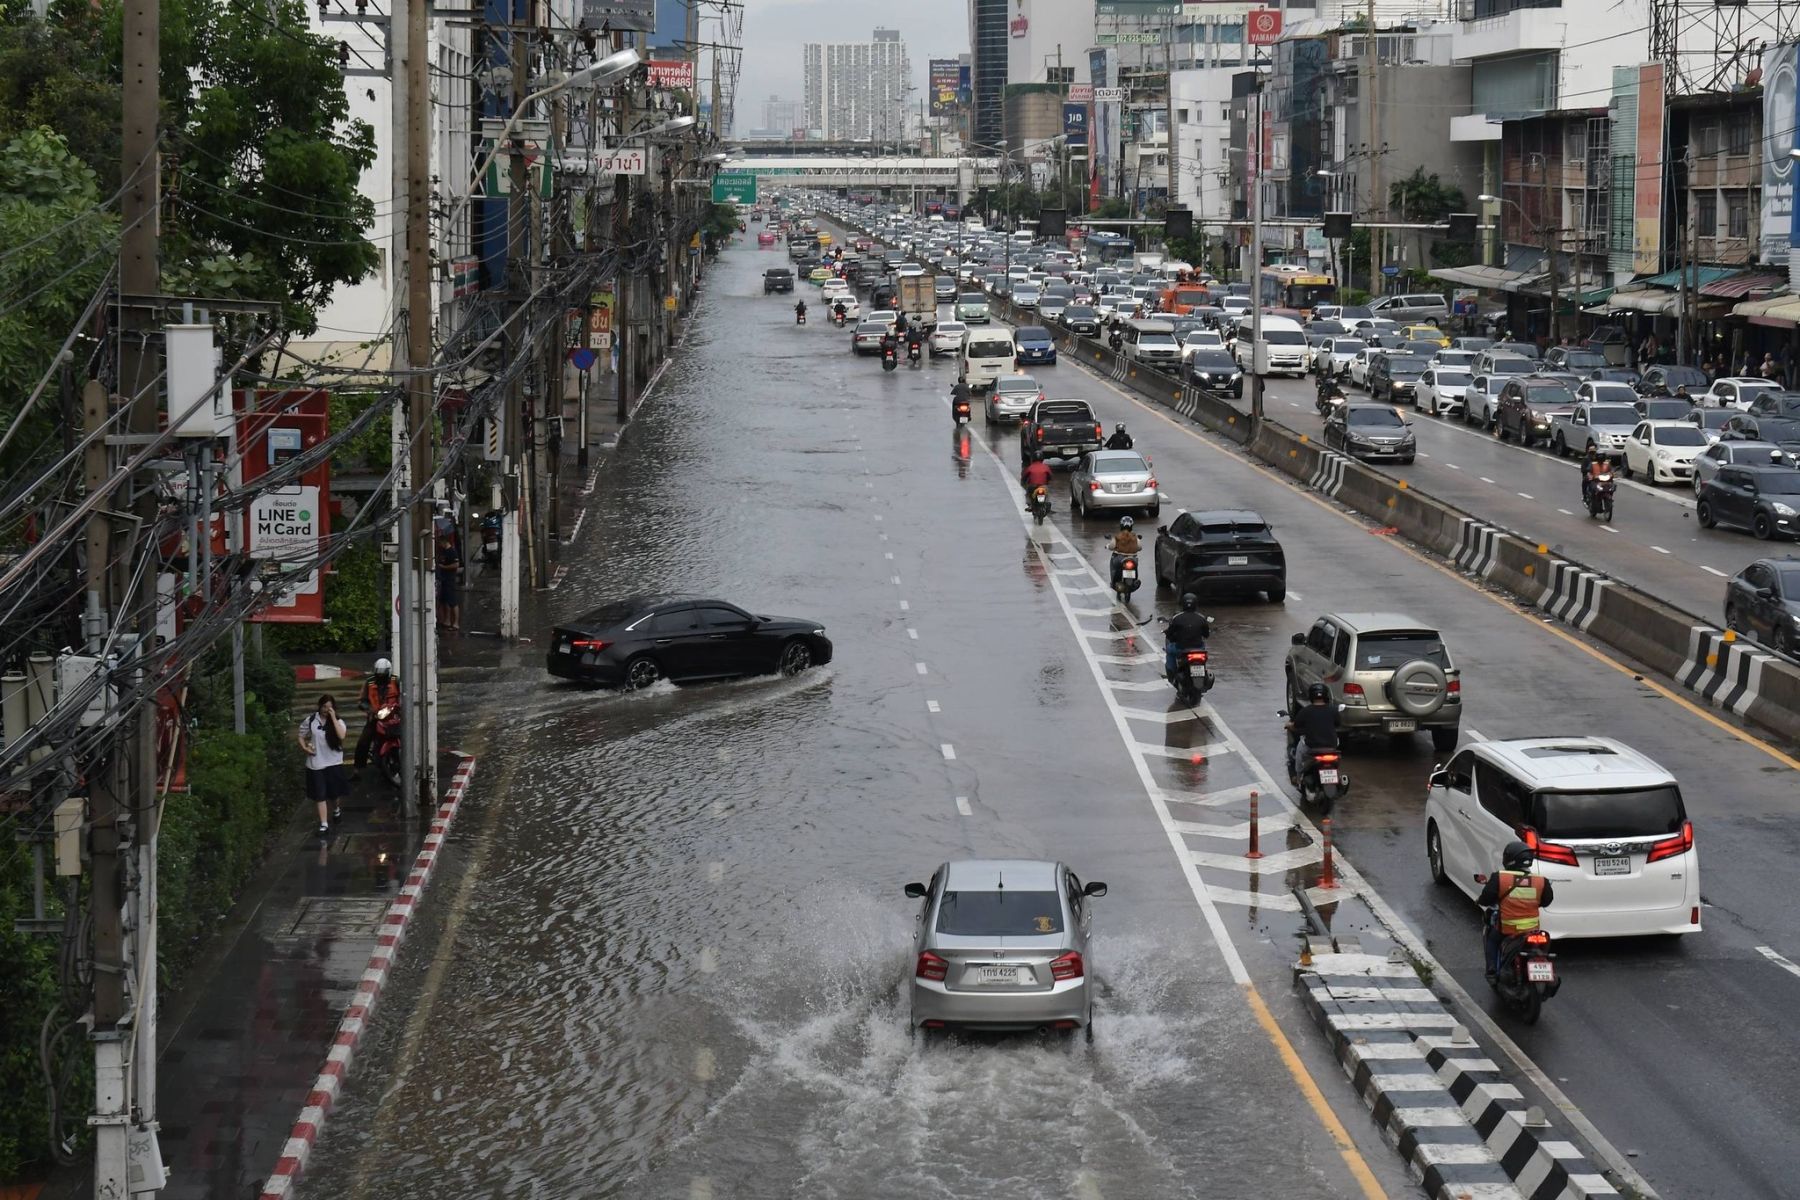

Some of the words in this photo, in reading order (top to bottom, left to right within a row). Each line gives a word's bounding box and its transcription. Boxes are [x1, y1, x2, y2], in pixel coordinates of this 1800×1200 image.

[258, 509, 295, 521] LINE
[258, 523, 271, 535] M
[274, 523, 311, 536] Card
[999, 968, 1017, 977] 4225
